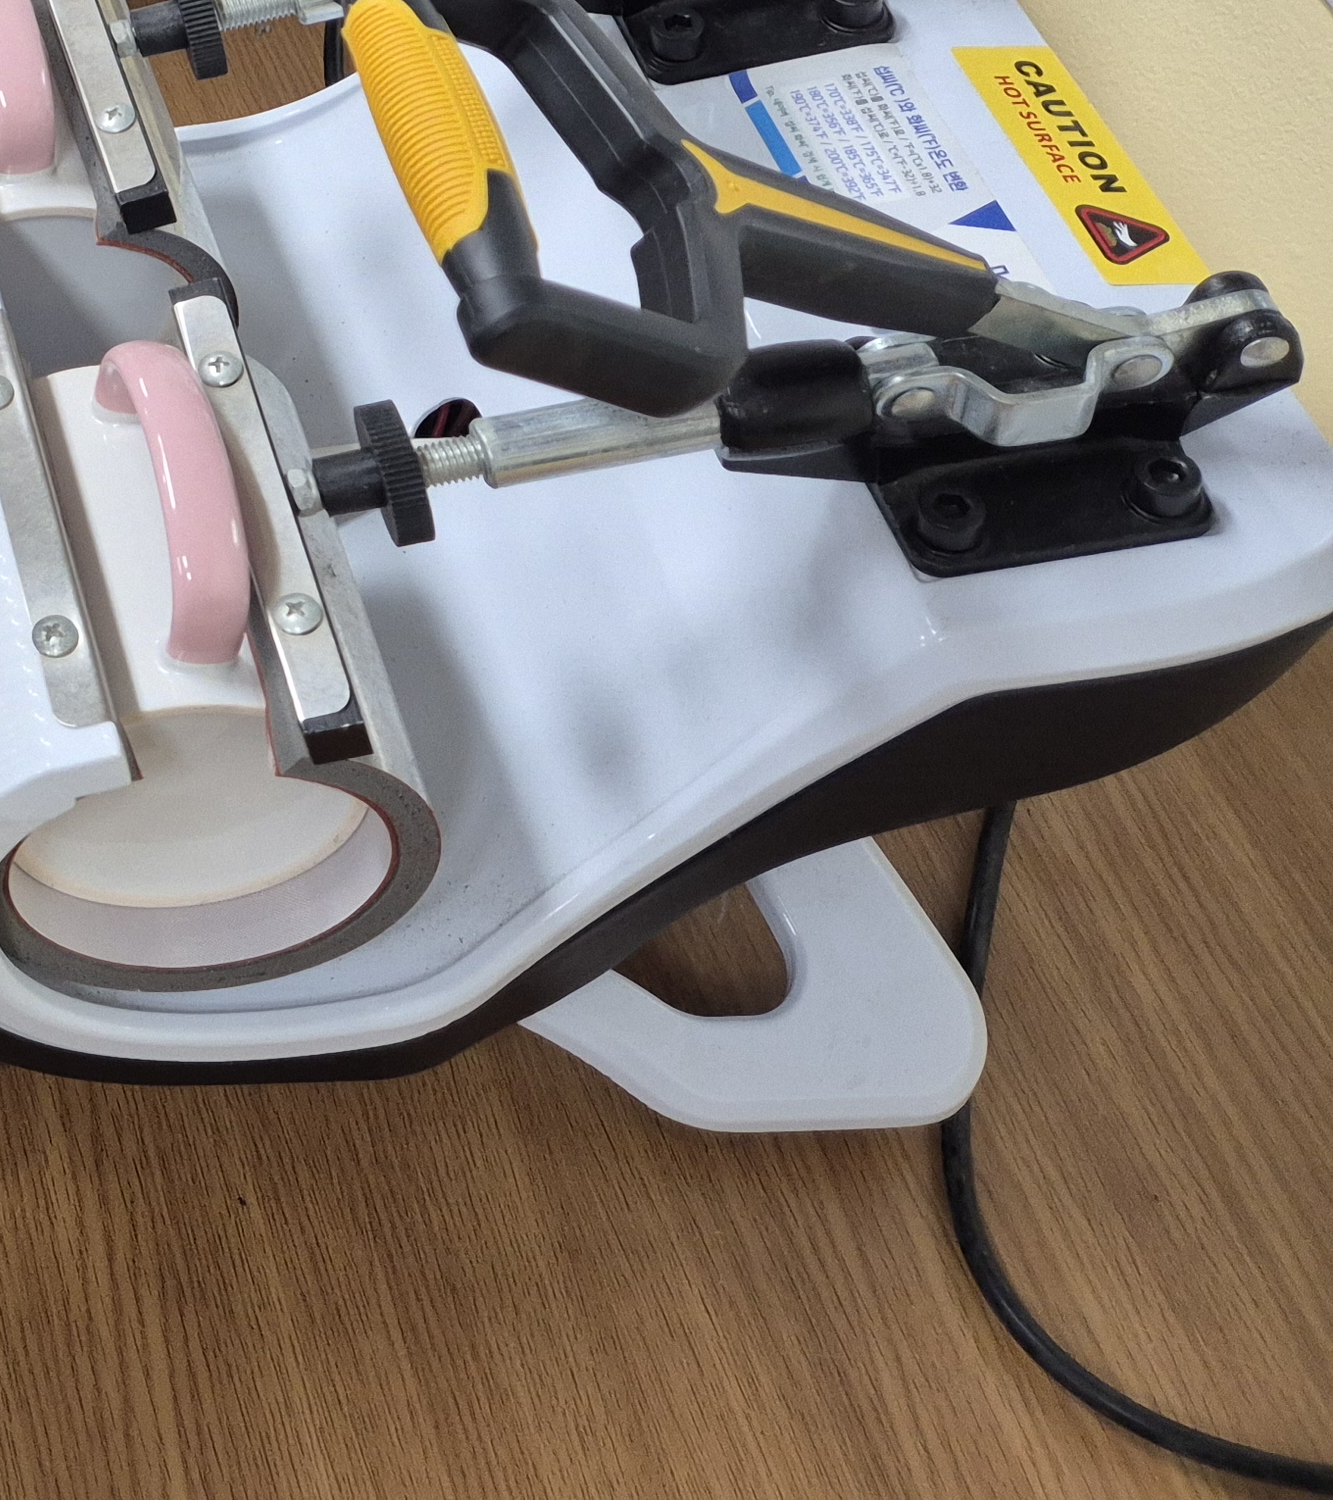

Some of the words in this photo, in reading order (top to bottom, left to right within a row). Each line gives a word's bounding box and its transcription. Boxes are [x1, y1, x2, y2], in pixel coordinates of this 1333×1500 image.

[994, 76, 1030, 107] HOT
[1018, 111, 1081, 182] SURFACE
[1014, 60, 1127, 192] CAUTION
[943, 171, 968, 192] 변환
